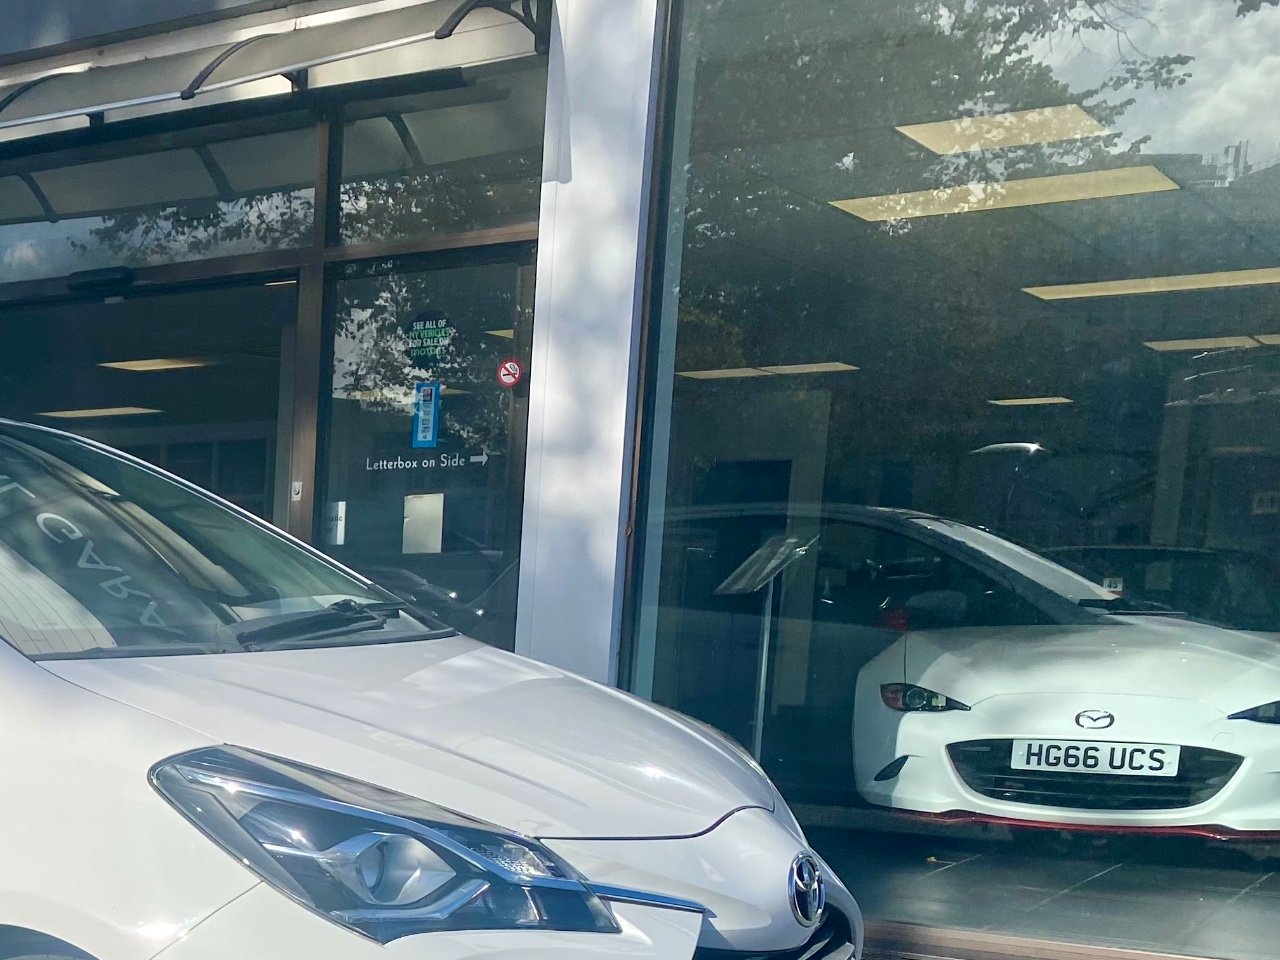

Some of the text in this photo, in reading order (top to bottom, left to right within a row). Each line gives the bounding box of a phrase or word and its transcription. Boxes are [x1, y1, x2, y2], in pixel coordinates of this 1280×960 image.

[412, 319, 447, 330] SEE ALL OF
[409, 339, 421, 348] FOR
[423, 337, 439, 347] SALE
[366, 453, 466, 470] Letterbox on Side
[1025, 743, 1166, 772] HG66 UCS
